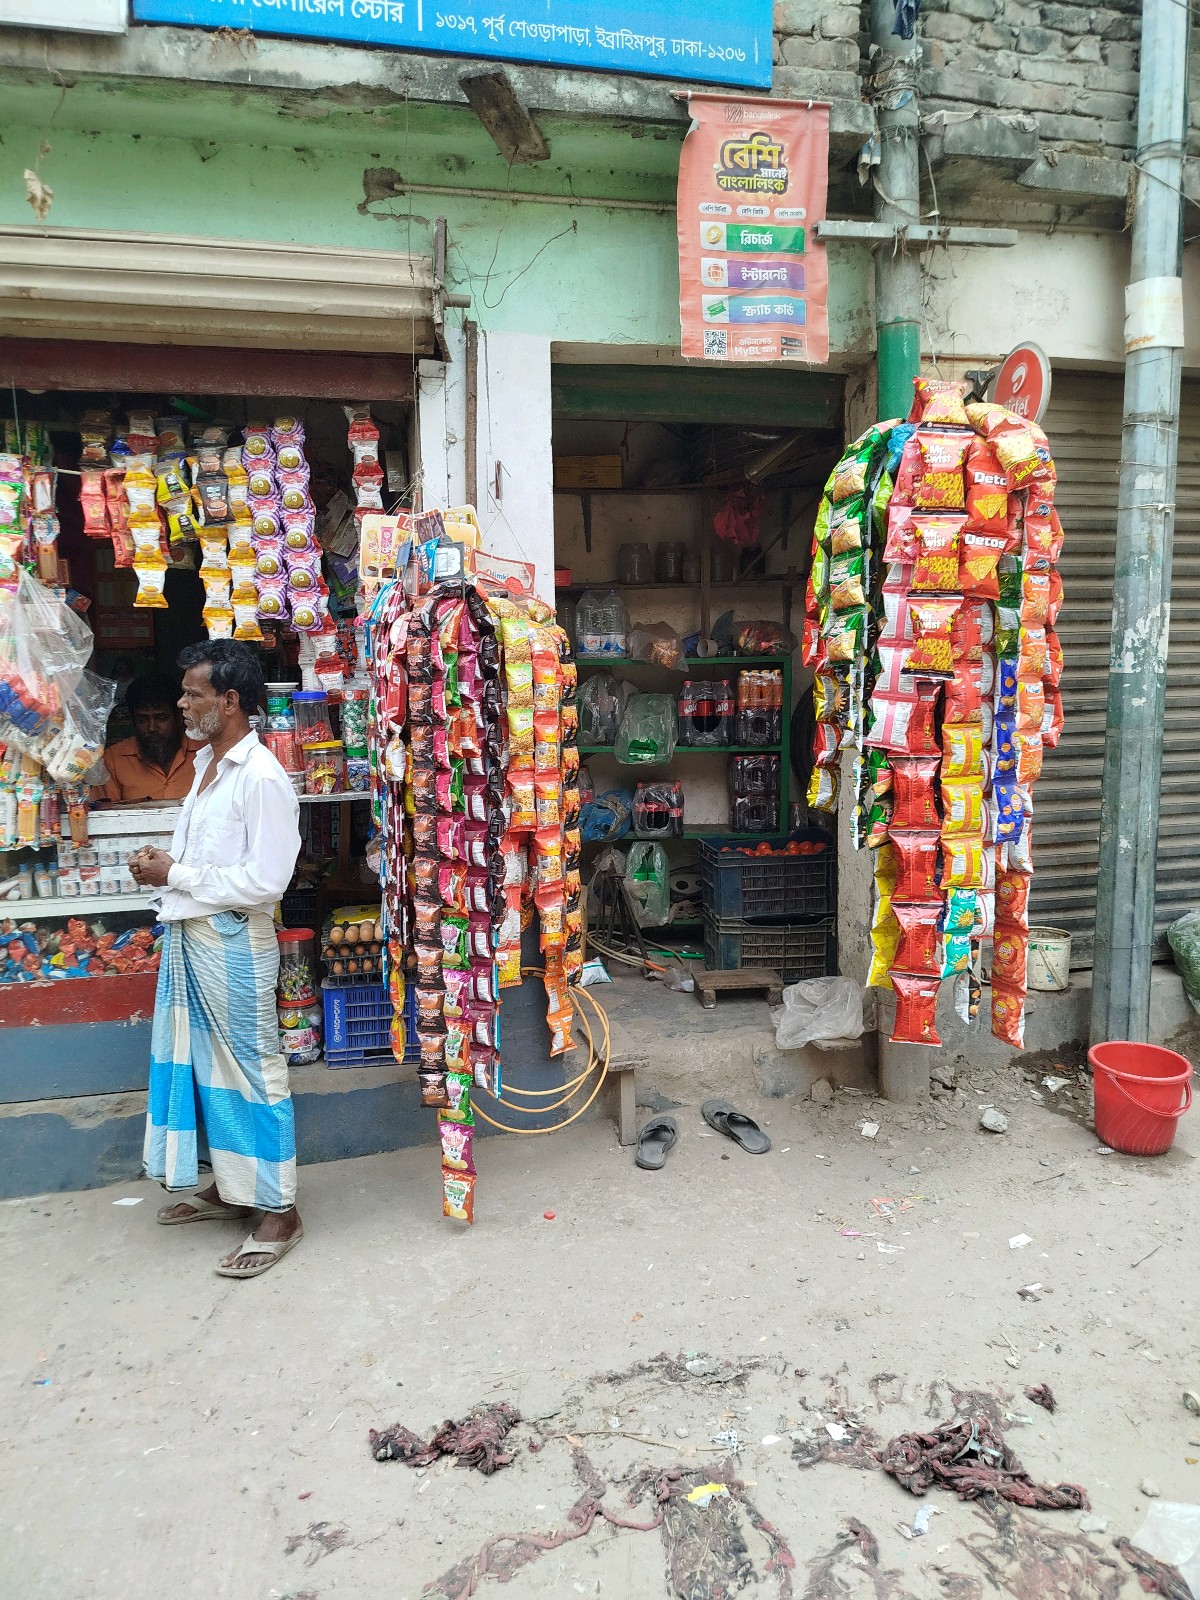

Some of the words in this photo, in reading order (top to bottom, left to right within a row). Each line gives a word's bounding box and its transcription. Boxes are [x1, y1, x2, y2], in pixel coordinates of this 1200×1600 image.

[351, 0, 405, 24] স্টোর
[435, 11, 478, 35] ১৩১৭,
[481, 14, 506, 42] পূর্ব
[508, 19, 593, 48] শেওড়াপাড়া,
[595, 24, 668, 59] ইব্রাহিমপুর,
[670, 38, 747, 62] ঢাকা-১২০৬
[724, 136, 781, 169] বেশি
[719, 174, 785, 191] বাংলালিংক
[739, 231, 774, 246] রিচার্জ
[740, 265, 788, 282] ইন্টারনেট
[774, 302, 795, 317] কার্ড
[973, 471, 1007, 486] Deto
